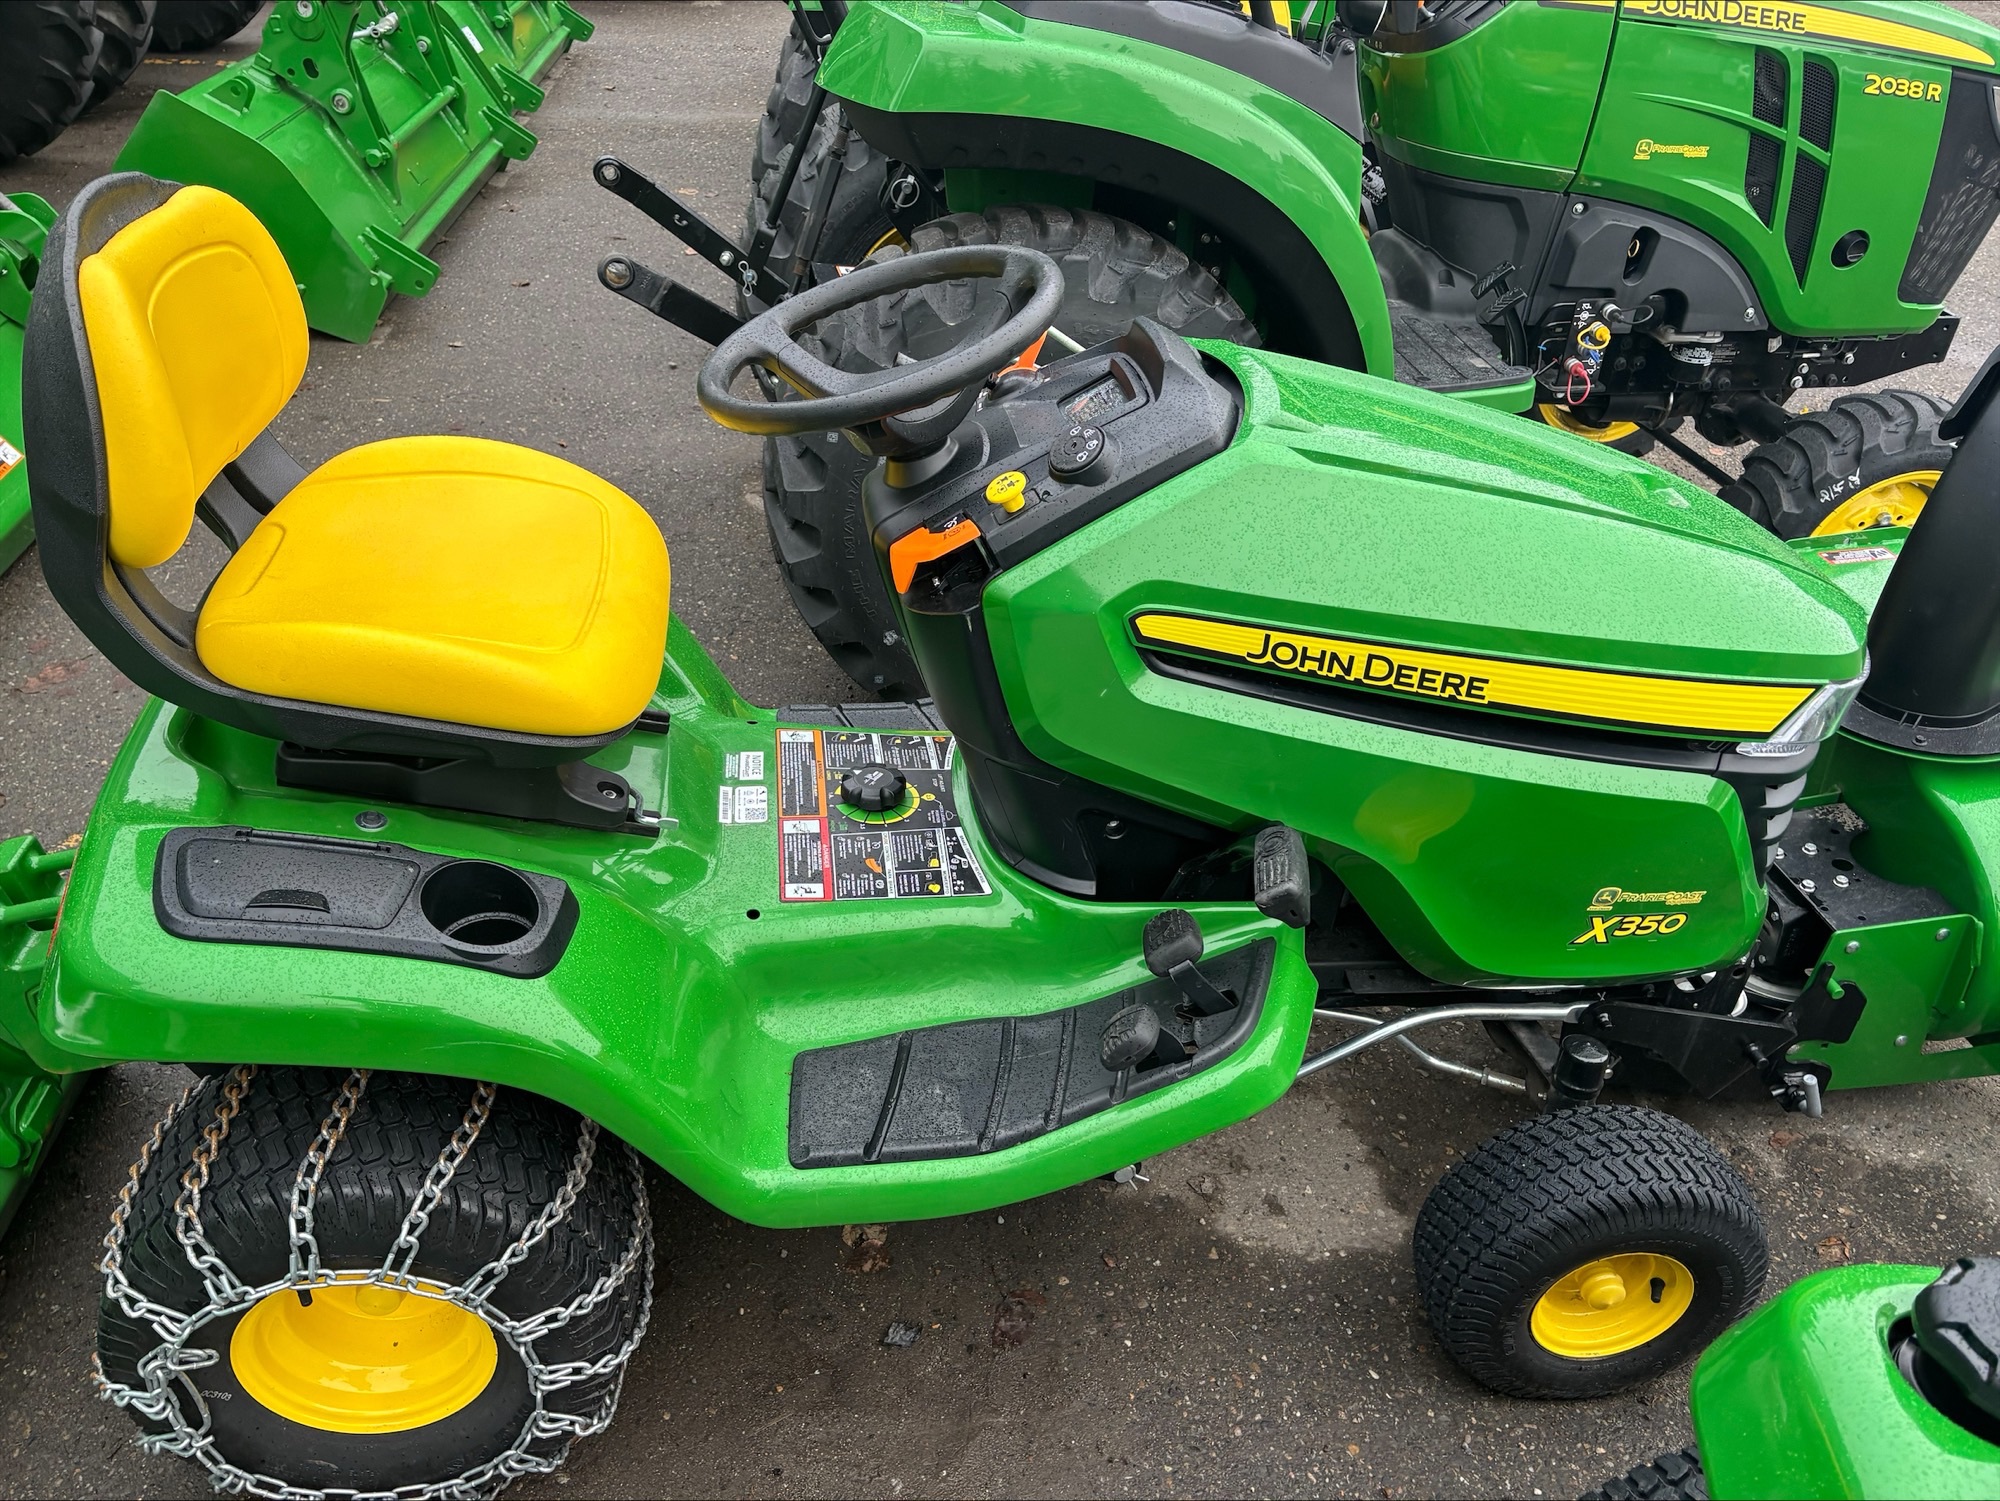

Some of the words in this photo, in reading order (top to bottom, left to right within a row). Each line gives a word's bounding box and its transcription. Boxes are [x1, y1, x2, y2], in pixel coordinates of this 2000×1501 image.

[1724, 0, 1807, 31] DEERE
[1246, 633, 1356, 678] JOHN
[1362, 653, 1490, 701] DEERE
[752, 755, 761, 775] NOTICE
[1571, 912, 1688, 944] X350
